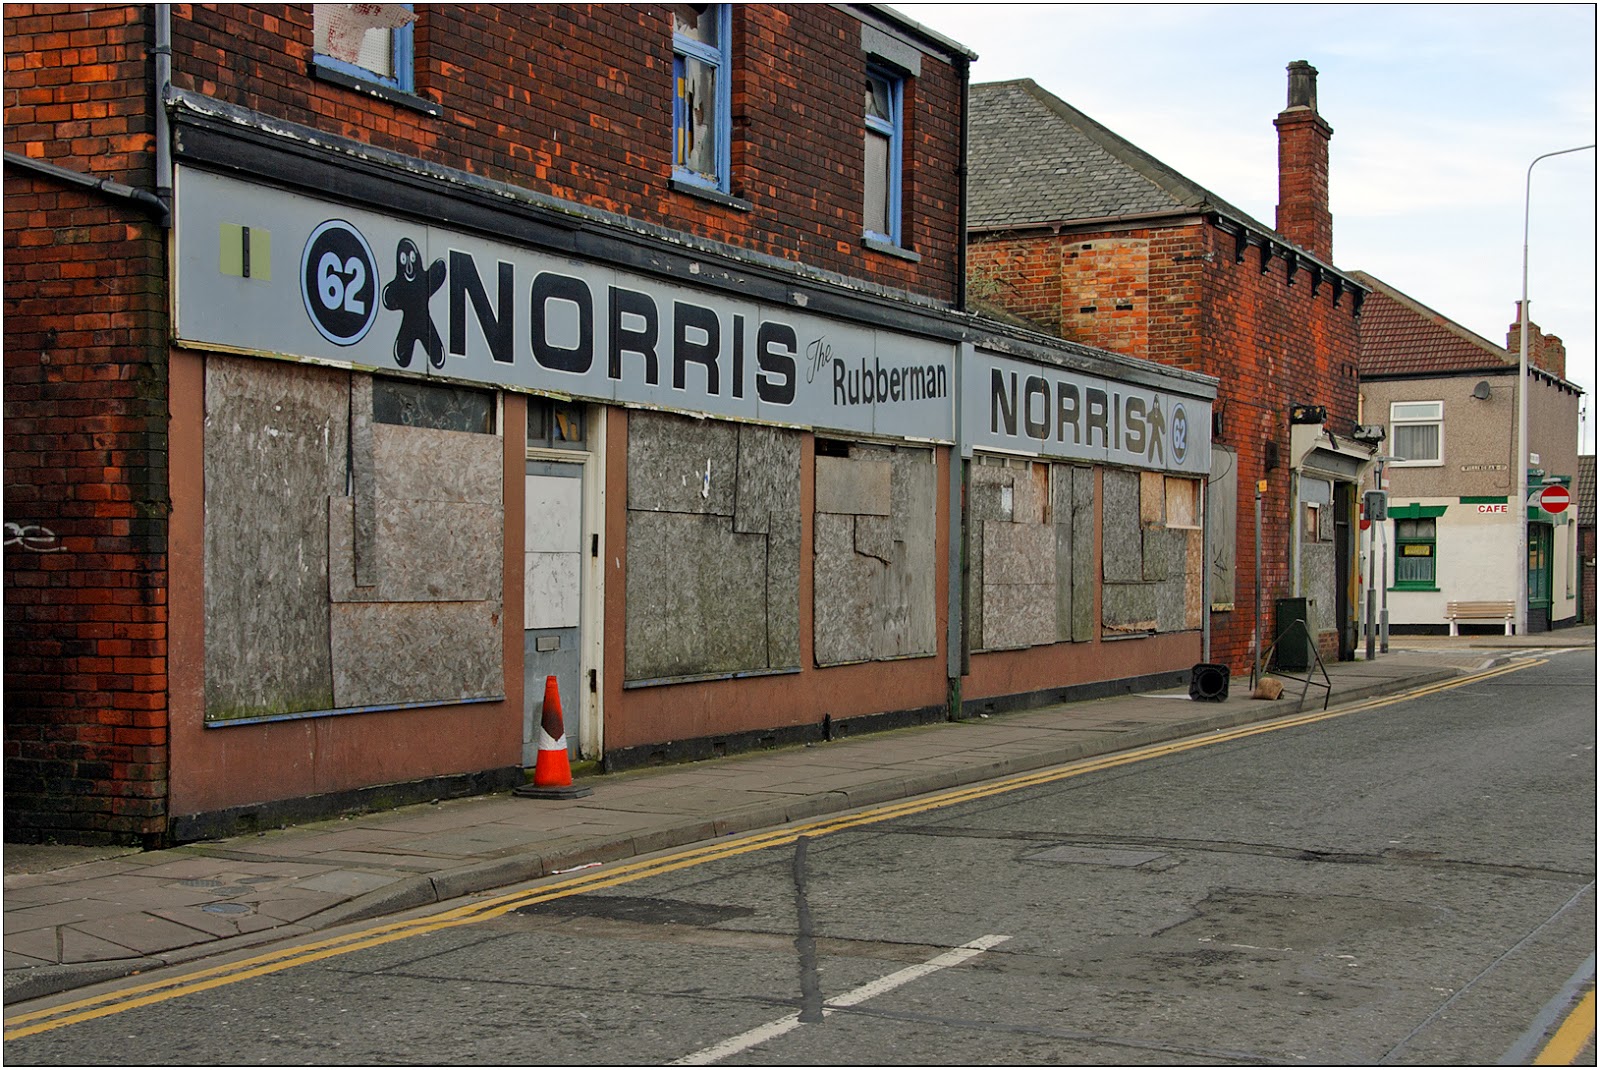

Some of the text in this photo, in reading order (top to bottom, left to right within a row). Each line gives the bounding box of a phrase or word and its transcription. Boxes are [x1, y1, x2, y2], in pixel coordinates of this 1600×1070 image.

[317, 247, 798, 406] 62 NORRIS
[806, 334, 947, 406] The Rubberman
[990, 364, 1186, 454] NORRIS 62
[1478, 505, 1508, 513] CAFE
